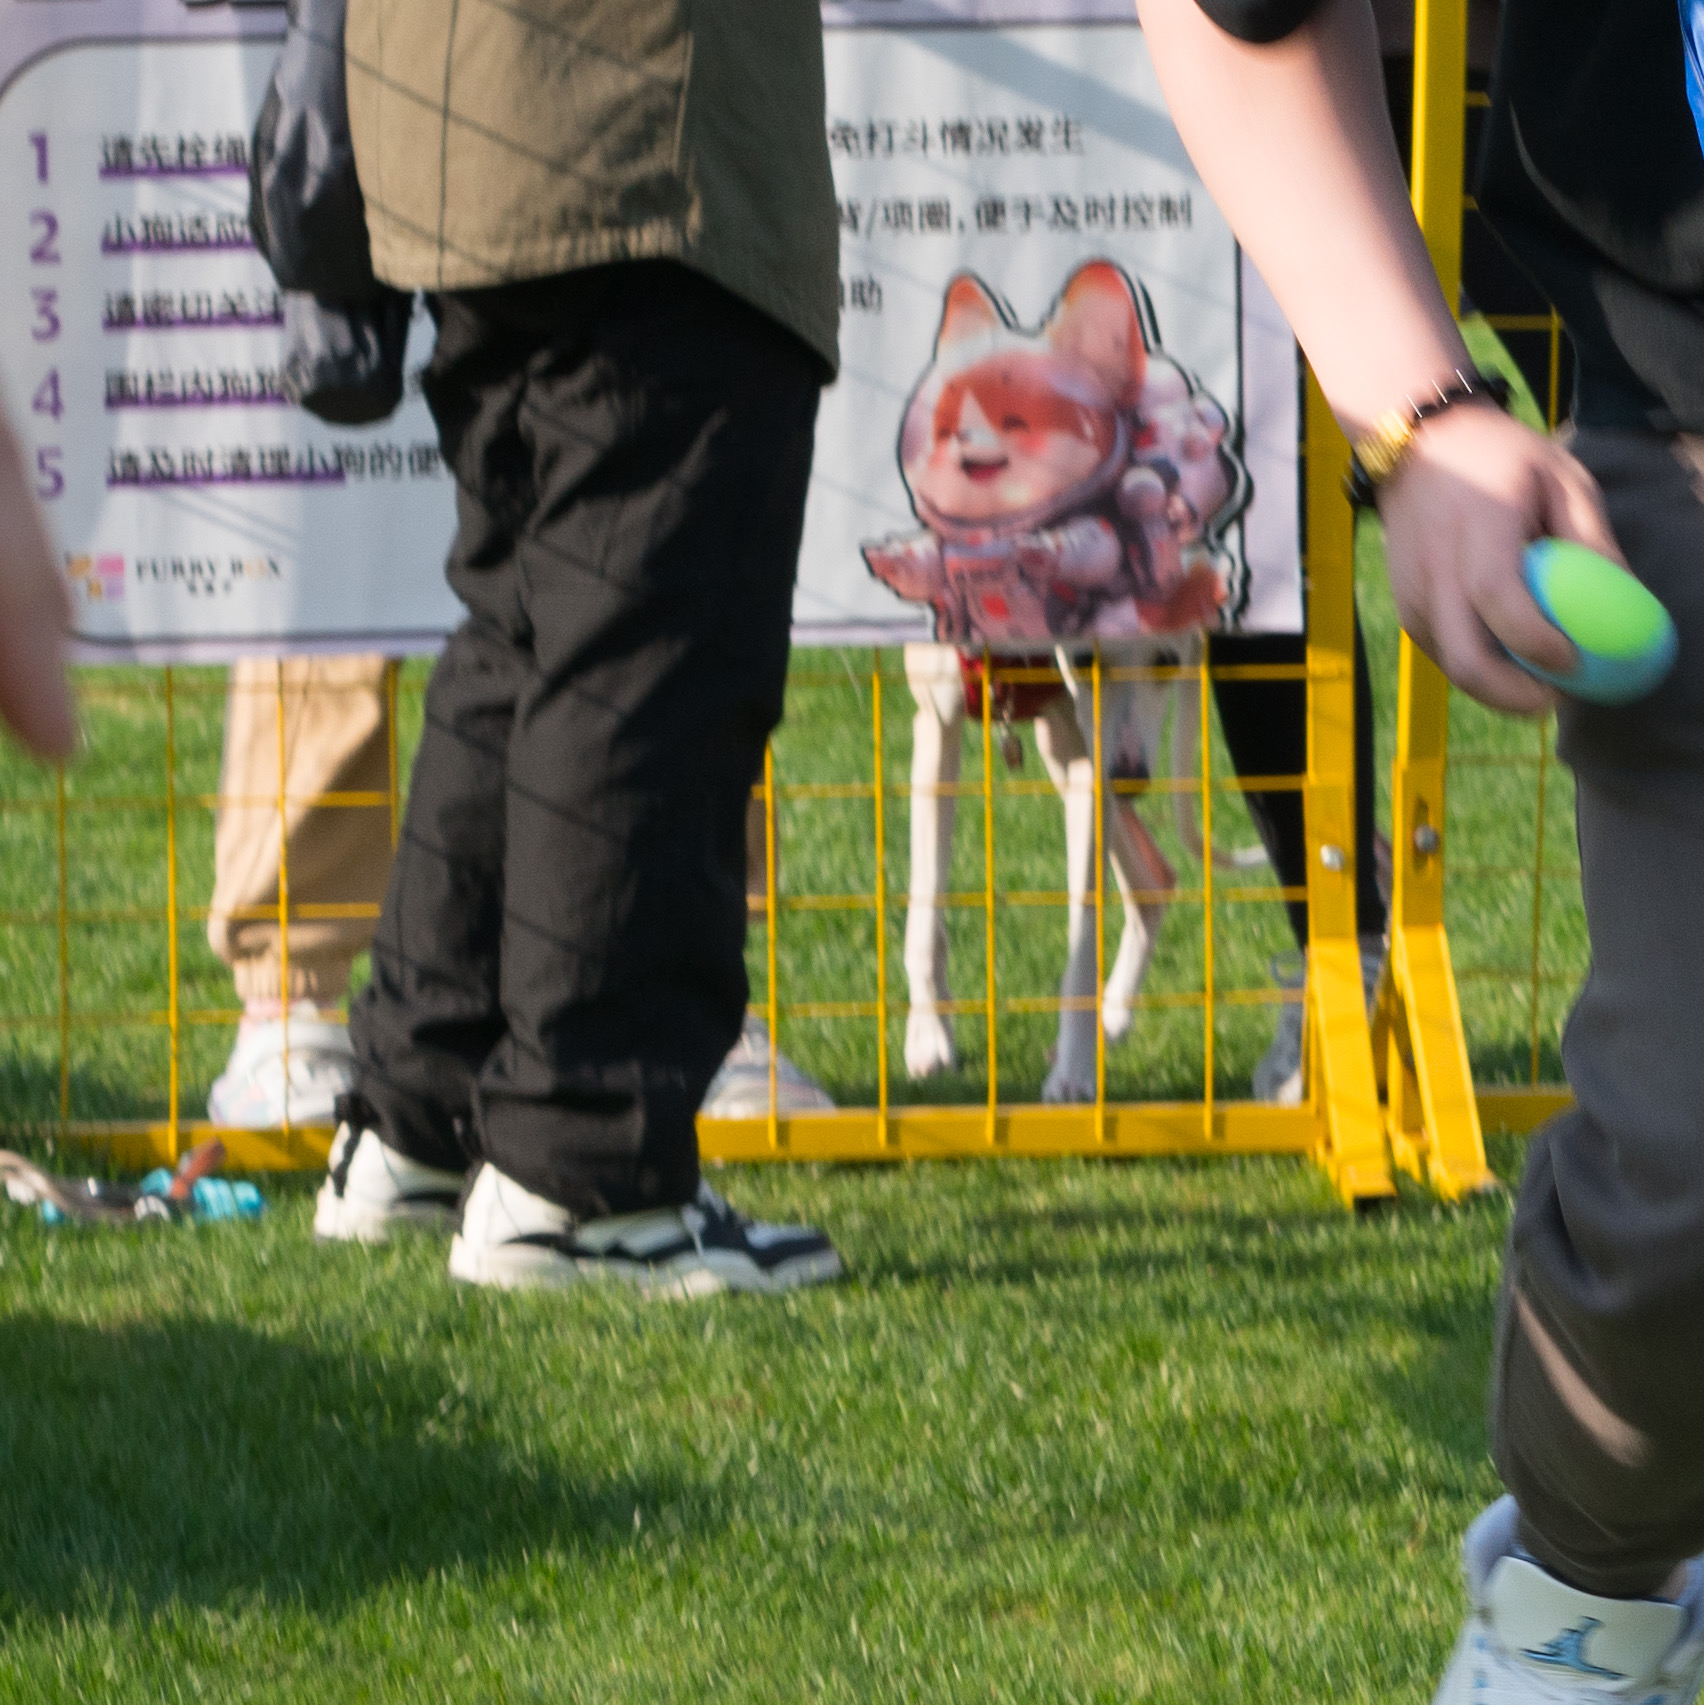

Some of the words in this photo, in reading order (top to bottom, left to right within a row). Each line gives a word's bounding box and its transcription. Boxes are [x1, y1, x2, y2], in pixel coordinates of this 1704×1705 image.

[30, 130, 48, 183] 1
[30, 208, 60, 263] 2
[30, 288, 60, 343] 3
[31, 369, 63, 422] 4
[36, 446, 64, 499] 5
